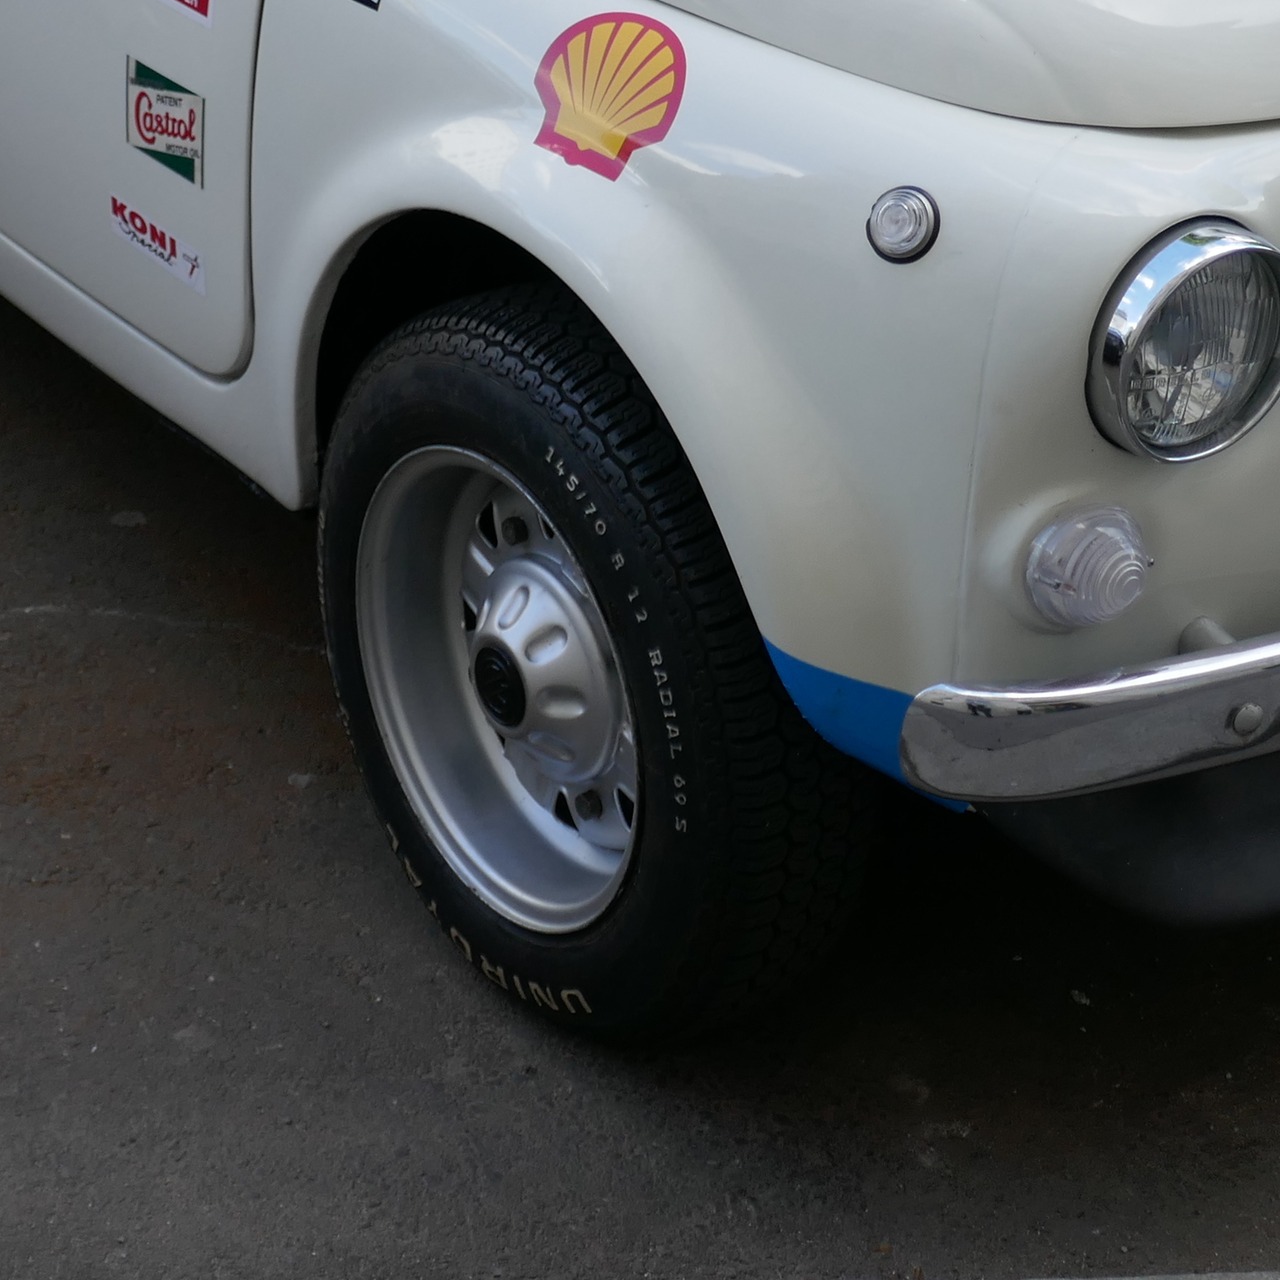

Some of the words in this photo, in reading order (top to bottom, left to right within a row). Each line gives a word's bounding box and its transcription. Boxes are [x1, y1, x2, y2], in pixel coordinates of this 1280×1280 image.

[134, 91, 196, 145] Castrol
[111, 195, 177, 259] KONI
[649, 648, 682, 760] RADIAL
